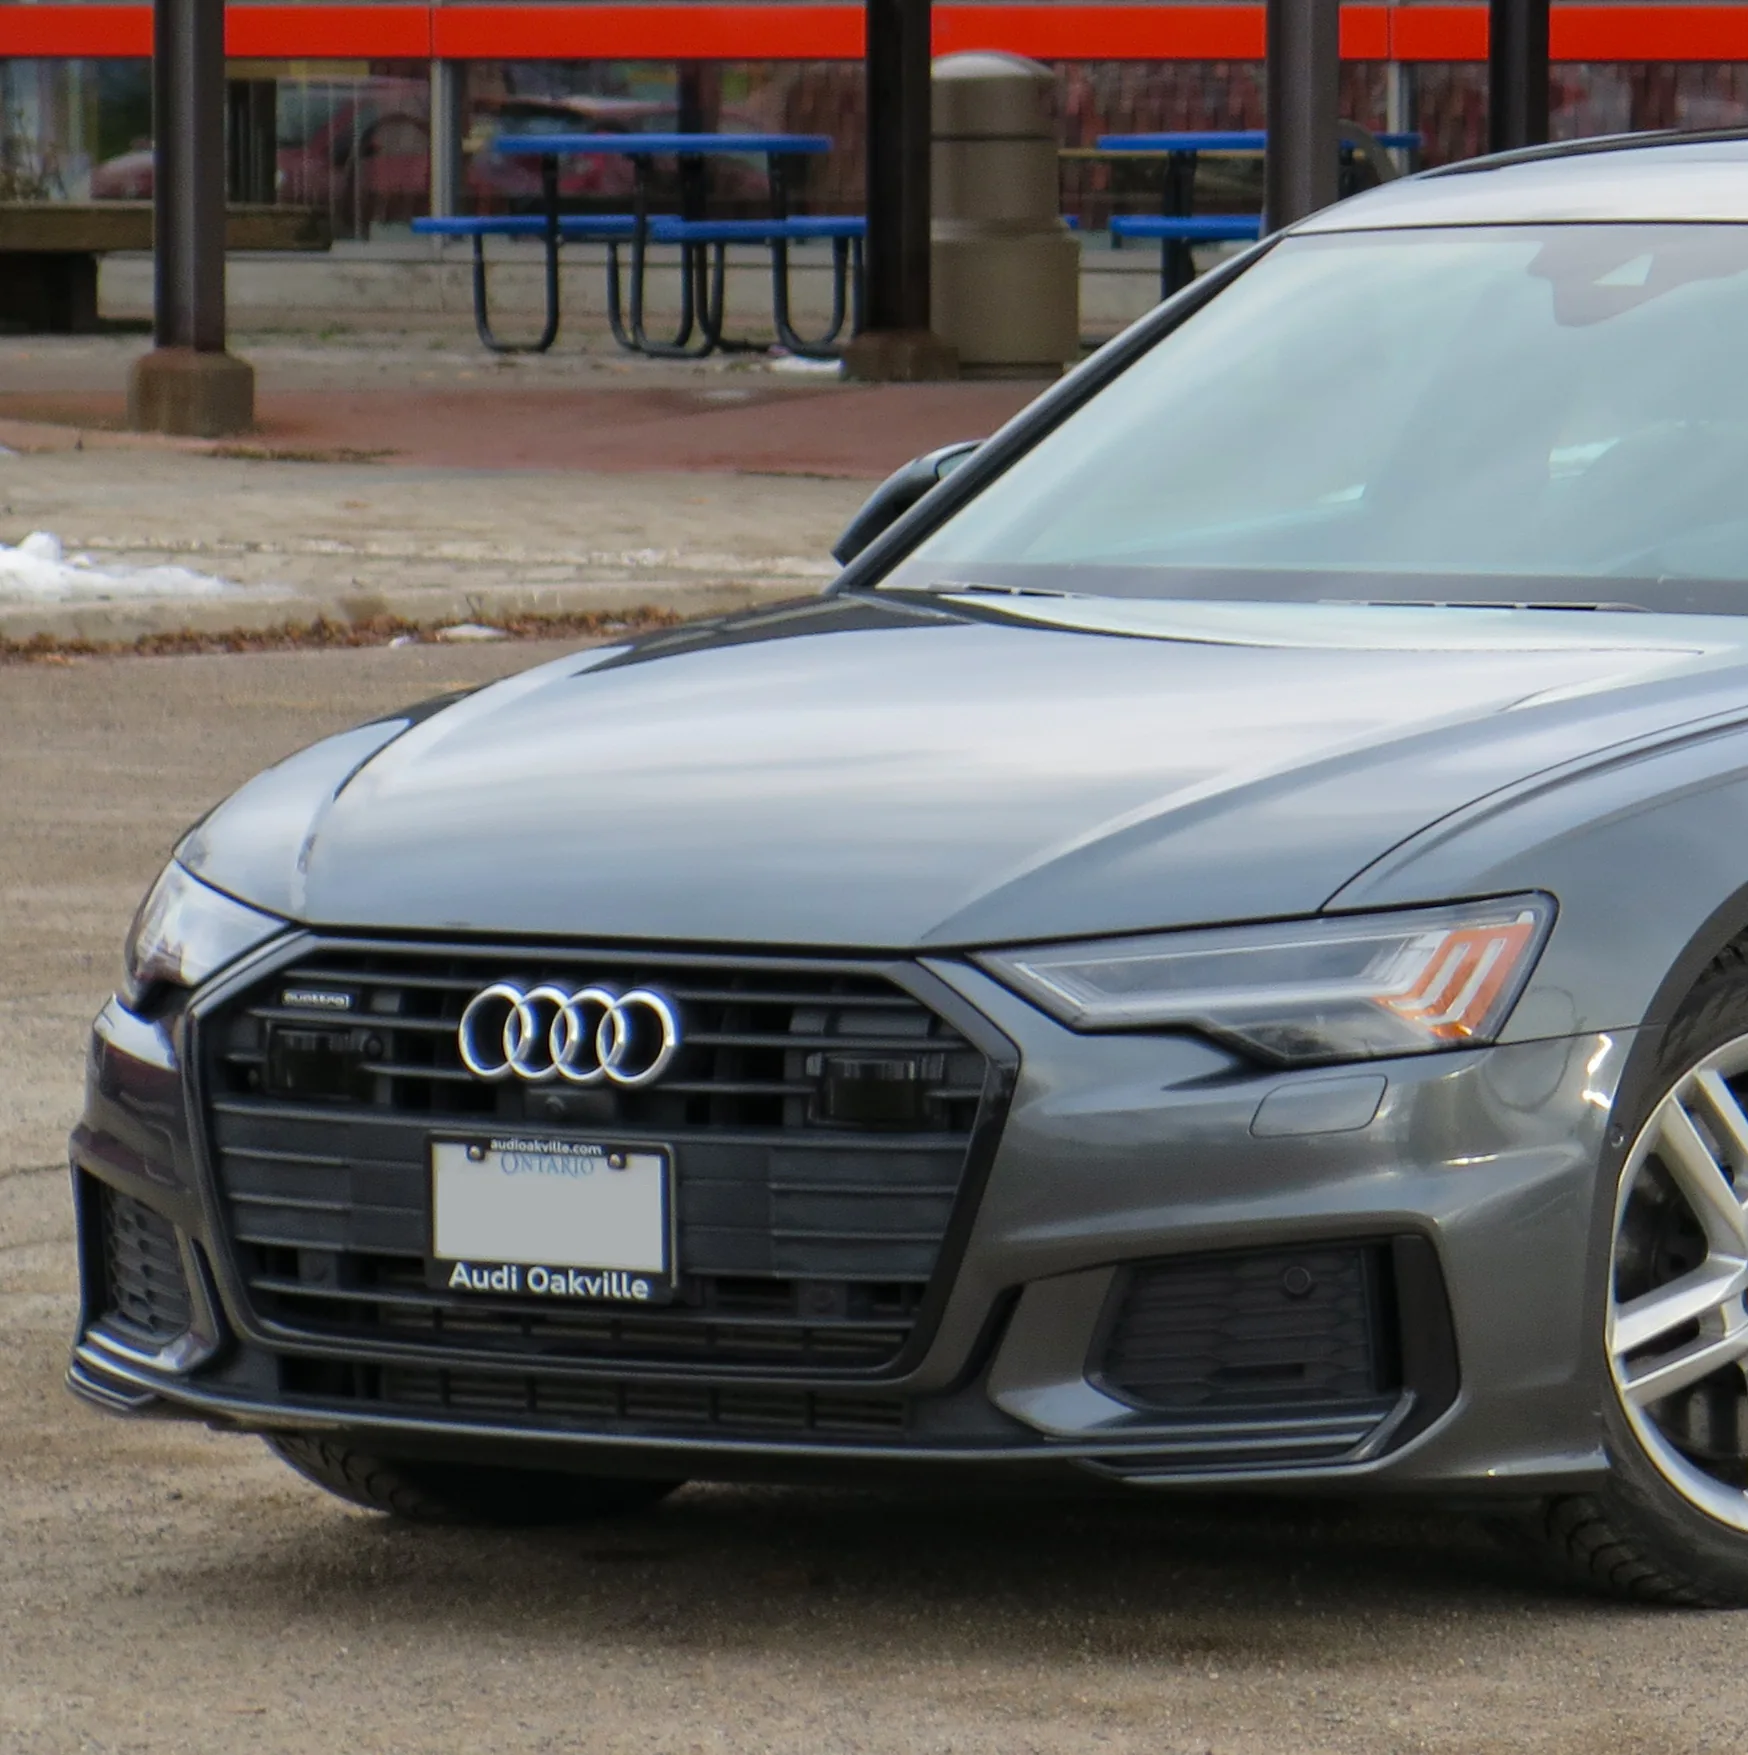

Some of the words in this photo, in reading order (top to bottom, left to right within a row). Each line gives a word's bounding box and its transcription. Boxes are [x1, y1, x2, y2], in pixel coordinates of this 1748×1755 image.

[490, 1139, 602, 1155] audioakville.com
[501, 1152, 594, 1178] ONTARIO
[448, 1262, 517, 1291] Audi
[527, 1266, 649, 1299] Oakville
